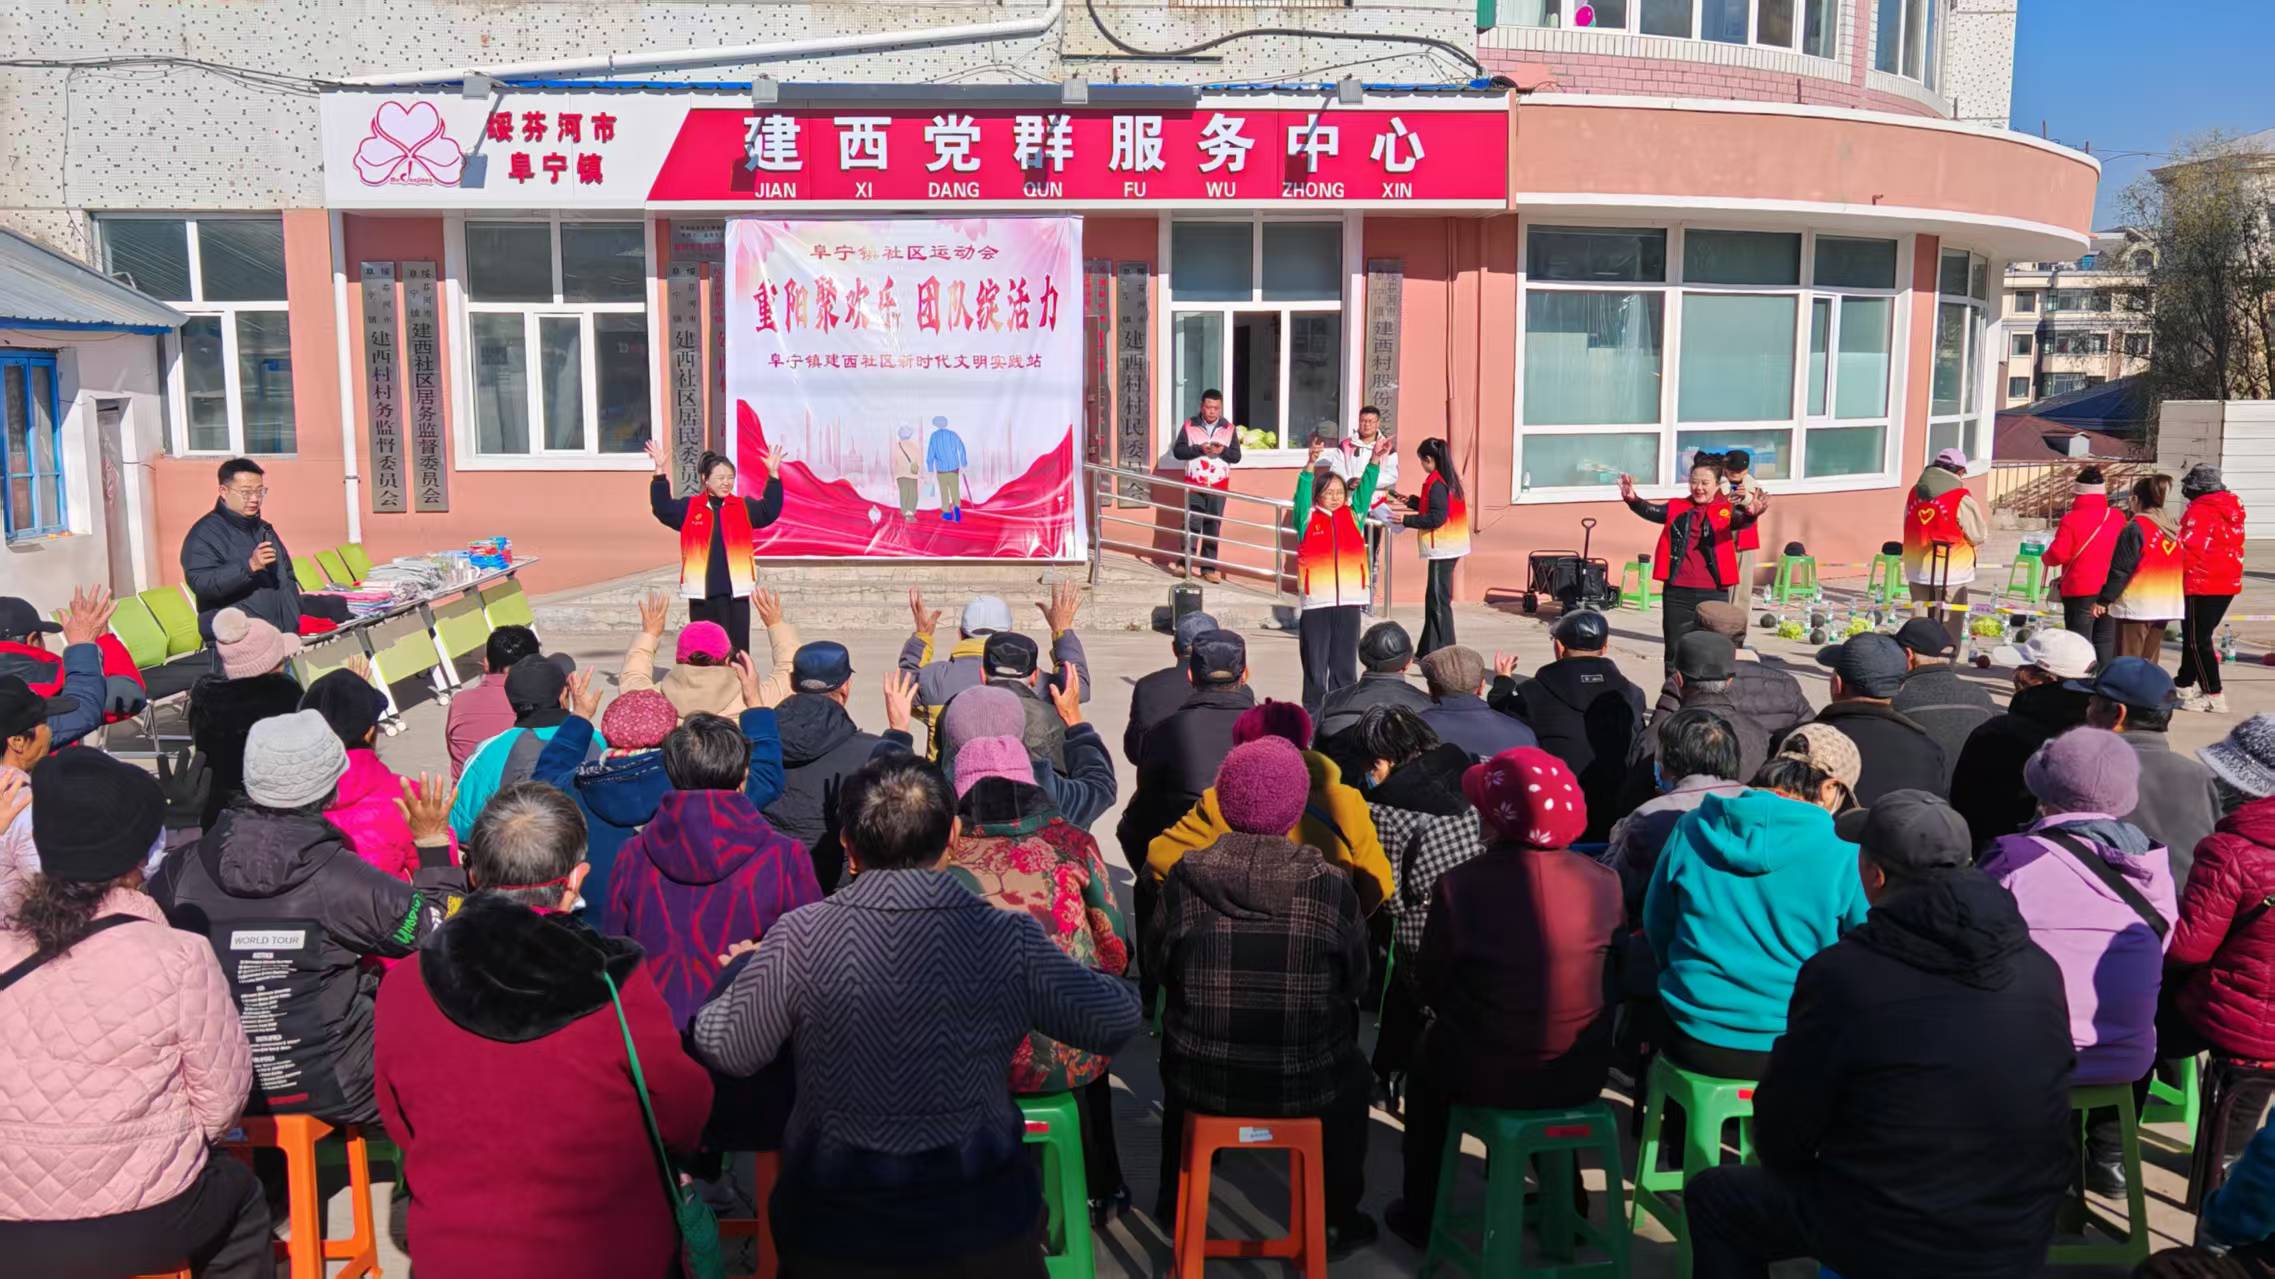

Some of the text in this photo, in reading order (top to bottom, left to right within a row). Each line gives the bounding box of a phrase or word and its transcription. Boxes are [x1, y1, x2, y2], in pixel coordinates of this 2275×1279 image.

[487, 111, 617, 144] 绥芬河市
[743, 113, 1426, 173] 建西党群服务中心
[508, 152, 605, 186] 阜宁镇
[754, 181, 1413, 199] JIAN XI DANG QUN FU WU ZHONG XIN
[809, 244, 1000, 262] 阜宁镇社区运动会
[767, 352, 1043, 369] 阜宁镇建西社区新时代文明实践站
[371, 329, 399, 508] 建西村村务监督委员会
[411, 321, 442, 504] 建西社区居务监督委员会
[234, 935, 300, 945] WORLD TOUR
